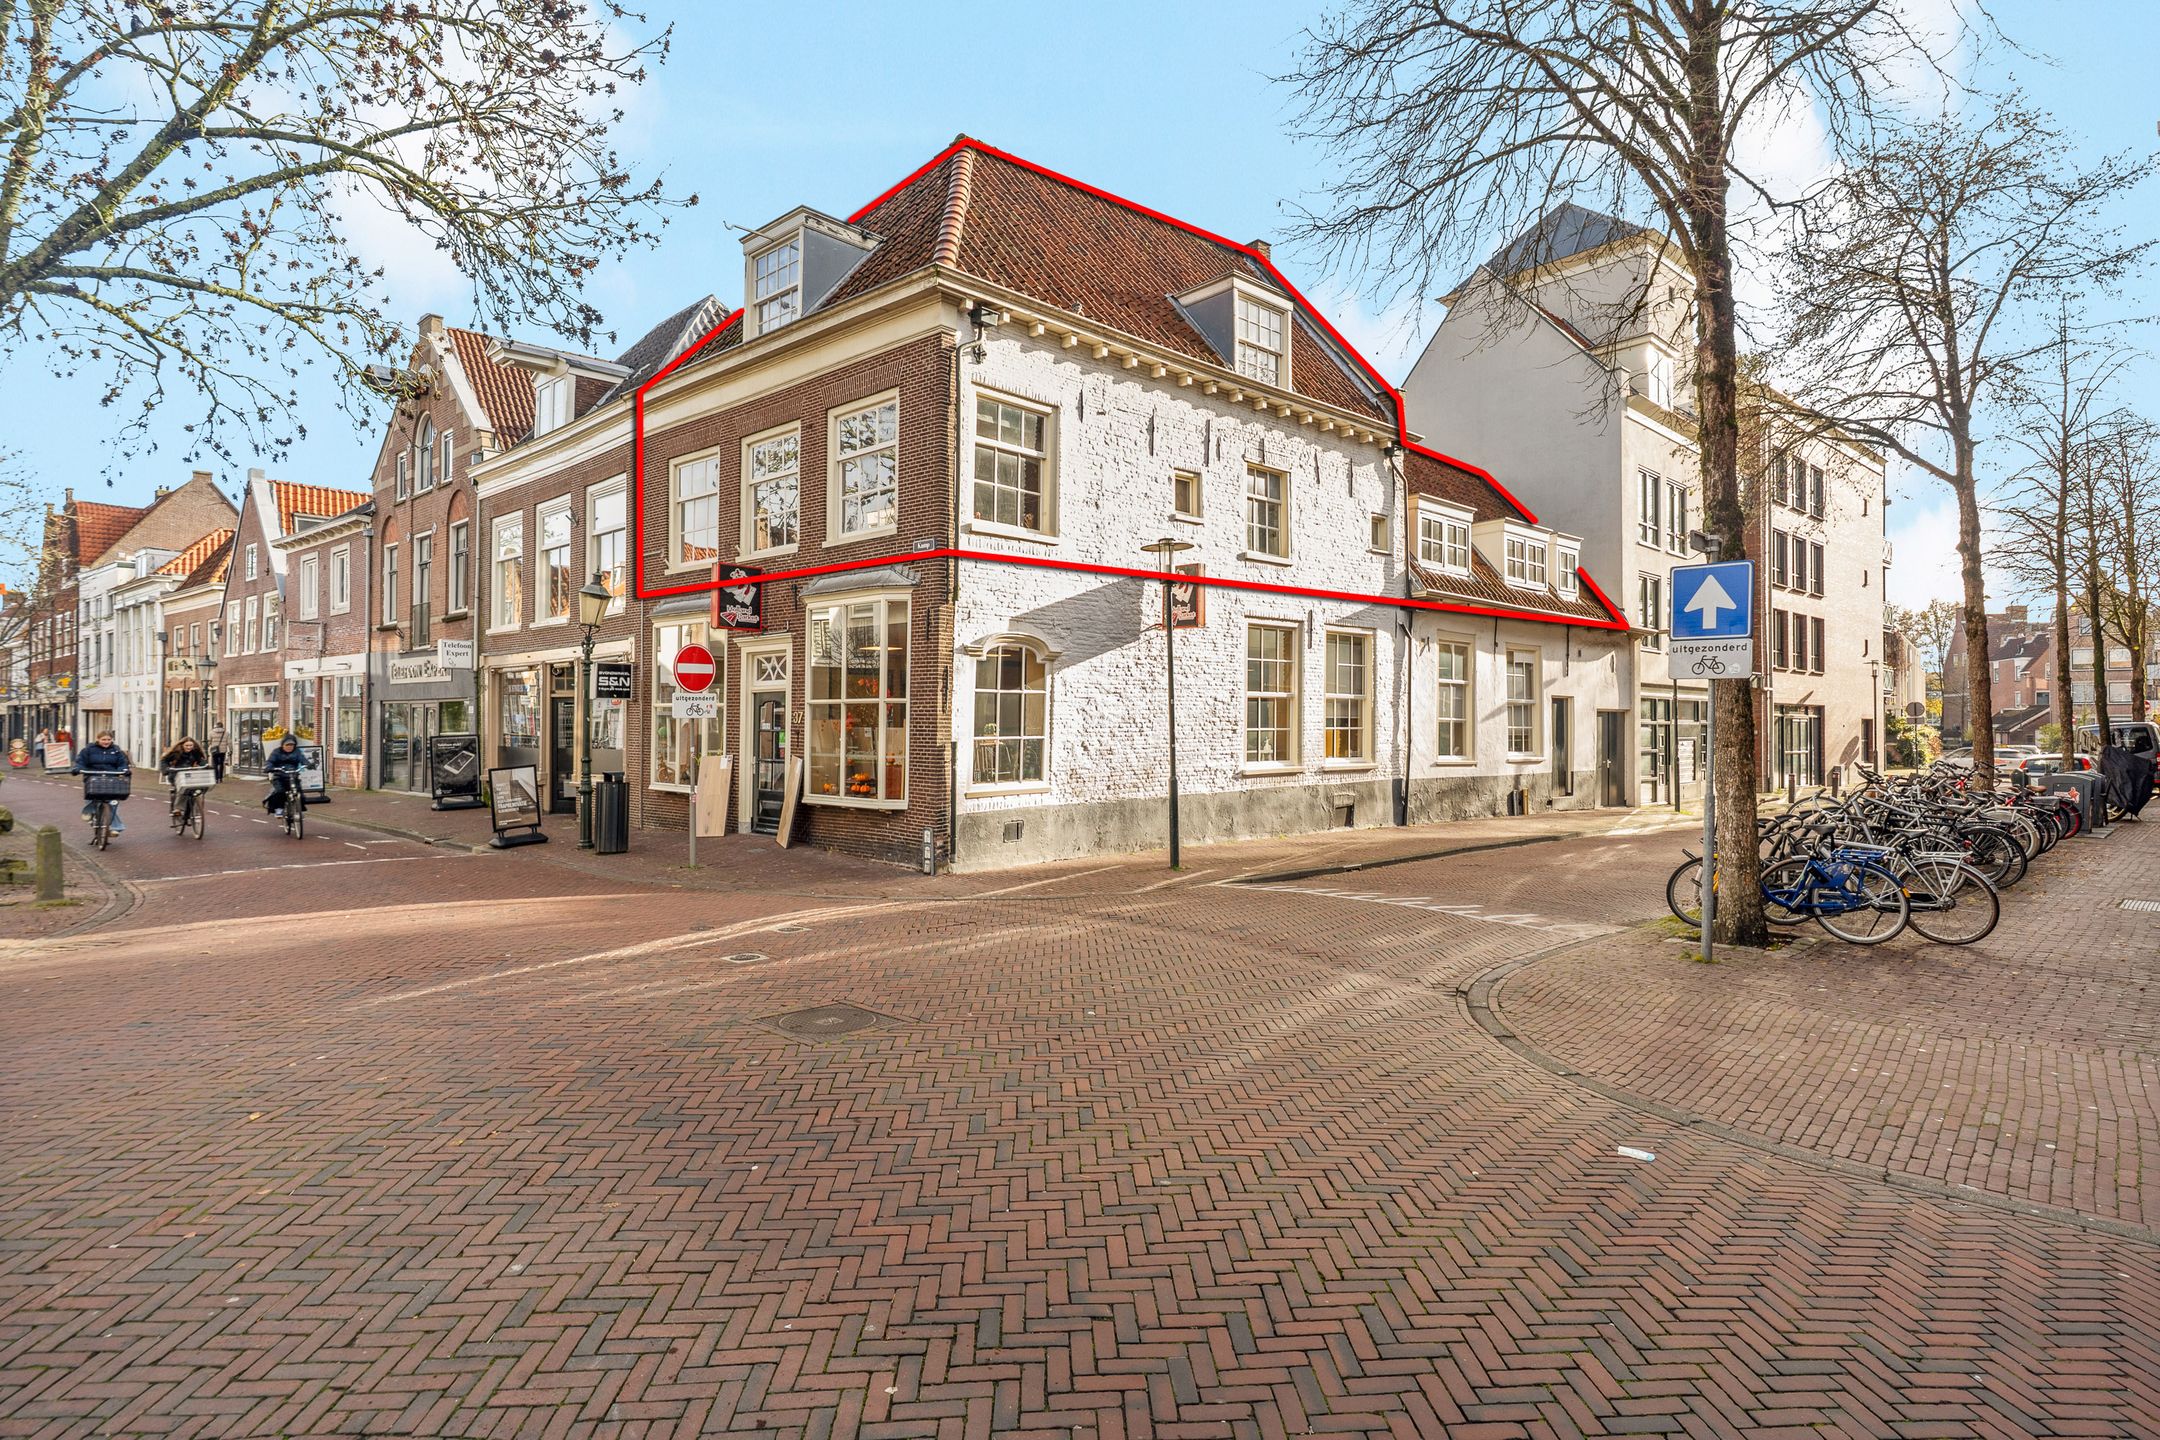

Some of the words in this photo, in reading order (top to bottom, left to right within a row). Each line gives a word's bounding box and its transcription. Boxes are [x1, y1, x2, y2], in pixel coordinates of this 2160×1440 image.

[444, 641, 472, 649] Telefoon
[1672, 643, 1748, 655] uitgezonderd
[446, 649, 469, 657] Expert
[598, 676, 630, 687] S&N
[793, 711, 803, 724] 37
